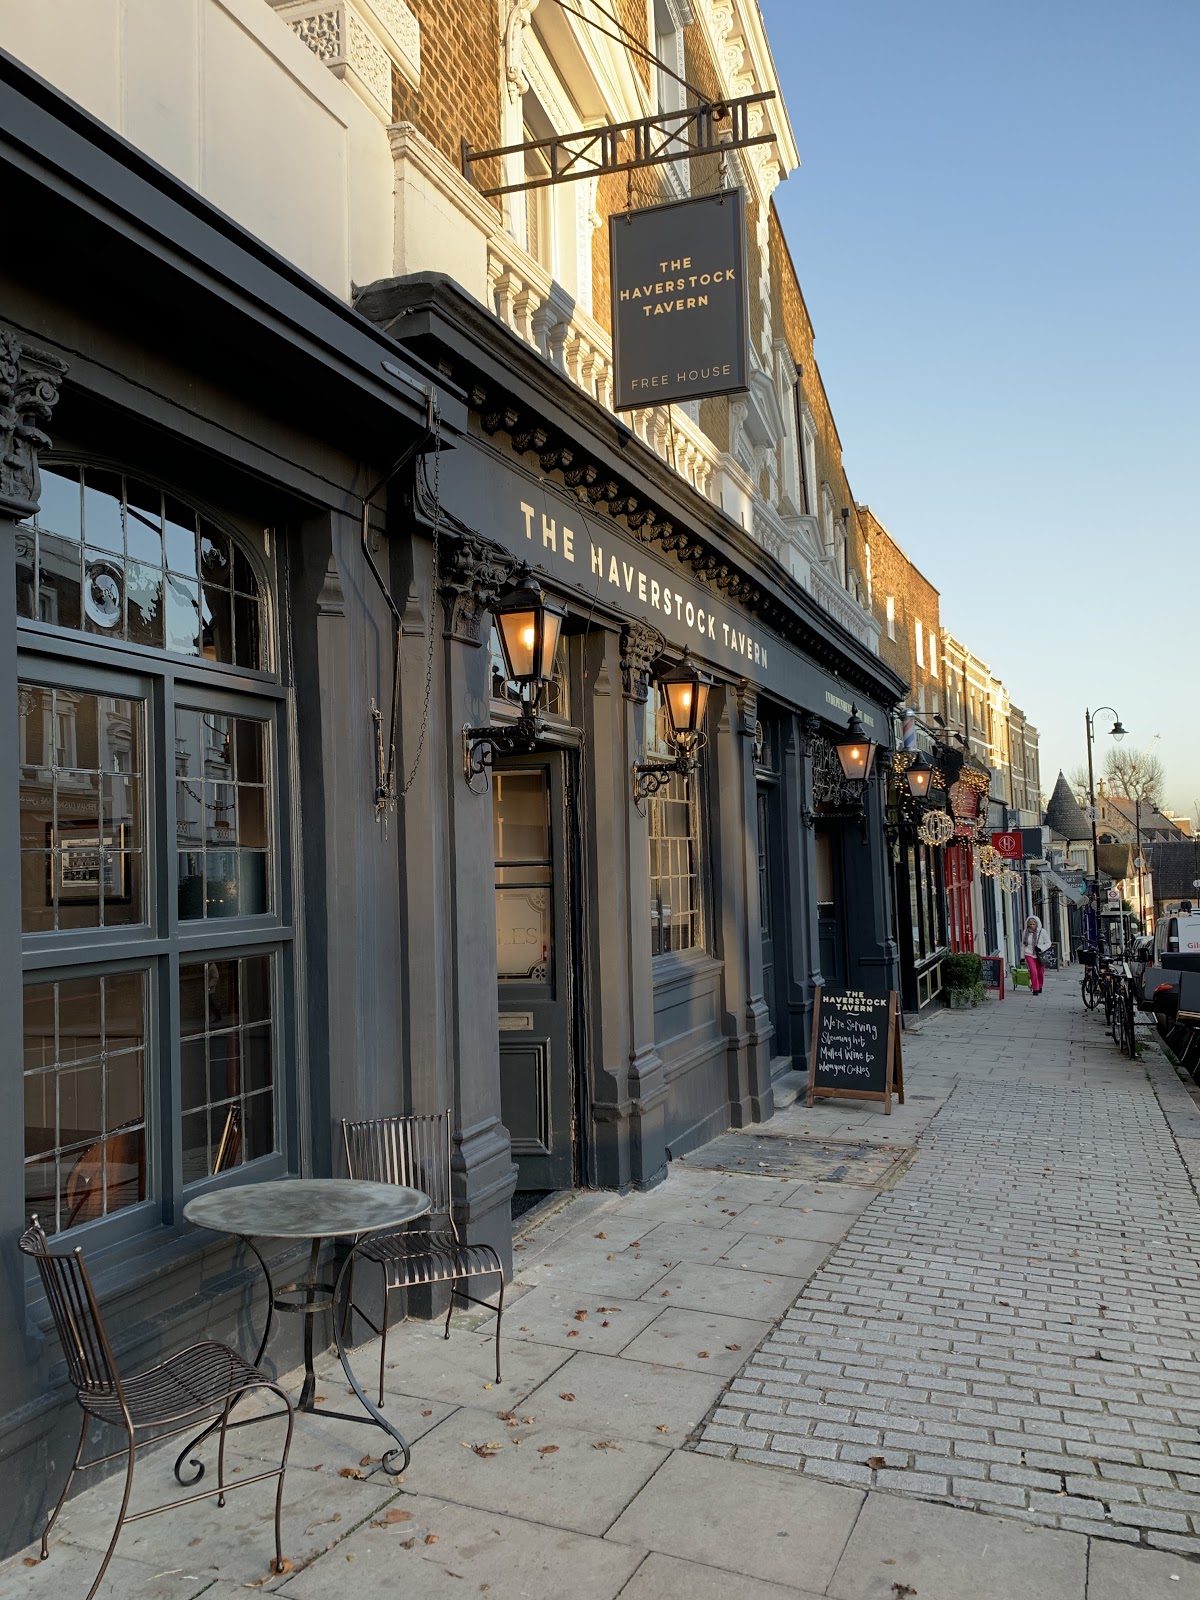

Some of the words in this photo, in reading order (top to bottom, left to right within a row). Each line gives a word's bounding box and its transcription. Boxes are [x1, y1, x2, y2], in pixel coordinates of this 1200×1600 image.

[659, 257, 692, 273] THE
[620, 268, 736, 301] HAVERSTOCK
[643, 295, 709, 317] TAVERN
[631, 374, 669, 390] FREE
[677, 364, 731, 383] HOUSE
[520, 501, 575, 563] THE
[591, 543, 716, 639] HAVERSTOCK
[722, 623, 768, 670] TAVERN
[822, 996, 887, 1007] HAVERSTOCK
[845, 990, 865, 998] THE
[835, 1003, 873, 1013] TAVERN
[865, 1051, 875, 1063] to
